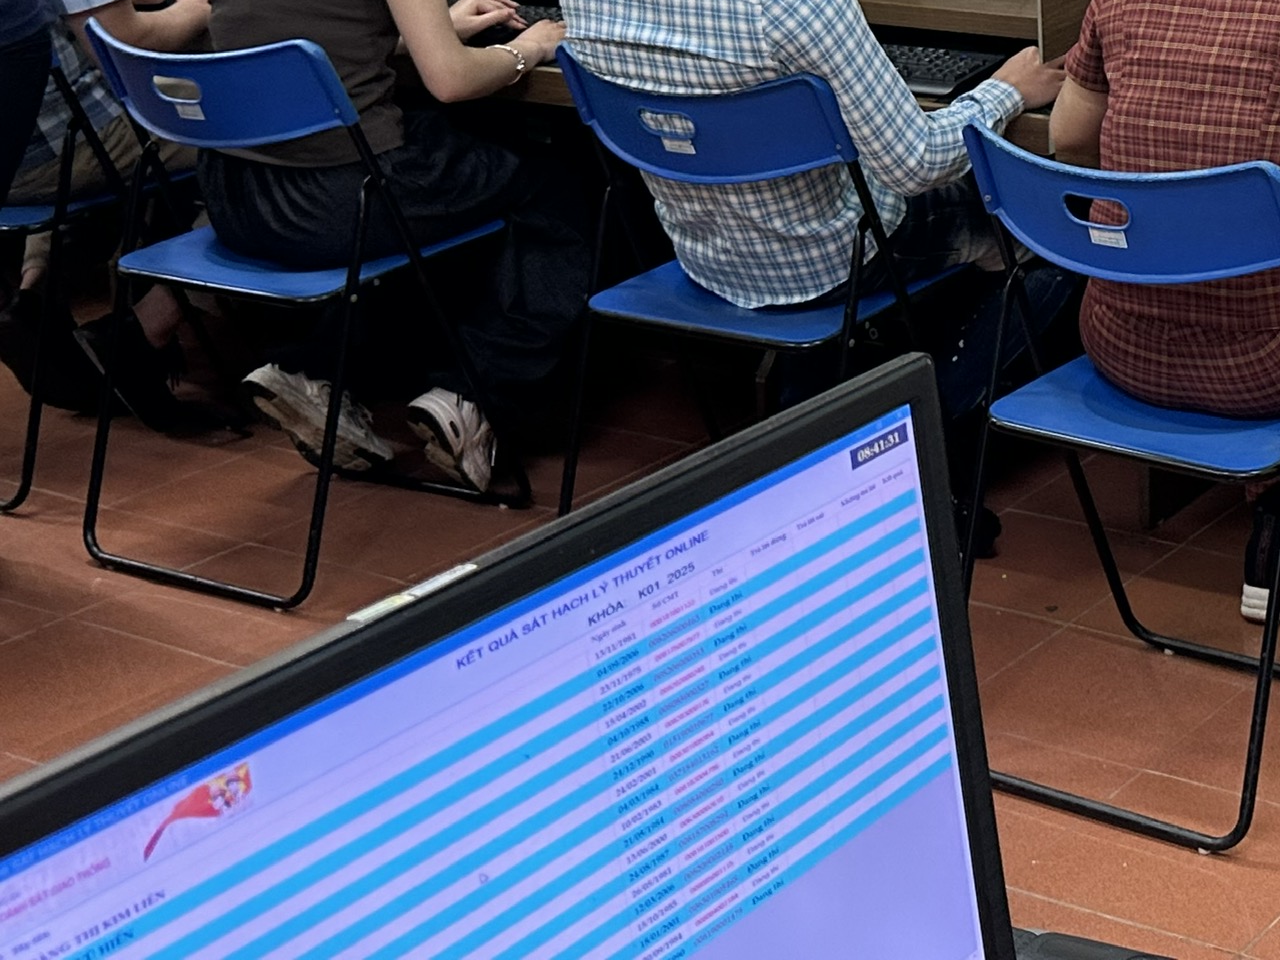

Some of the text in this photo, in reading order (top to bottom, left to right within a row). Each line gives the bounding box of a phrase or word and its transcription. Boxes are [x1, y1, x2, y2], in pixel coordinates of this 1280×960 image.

[857, 431, 900, 462] 08:41:31
[456, 648, 485, 670] KẾT
[522, 613, 548, 637] SÁT
[665, 530, 710, 560] ONLINE
[638, 581, 660, 600] K01
[667, 561, 695, 585] 2025
